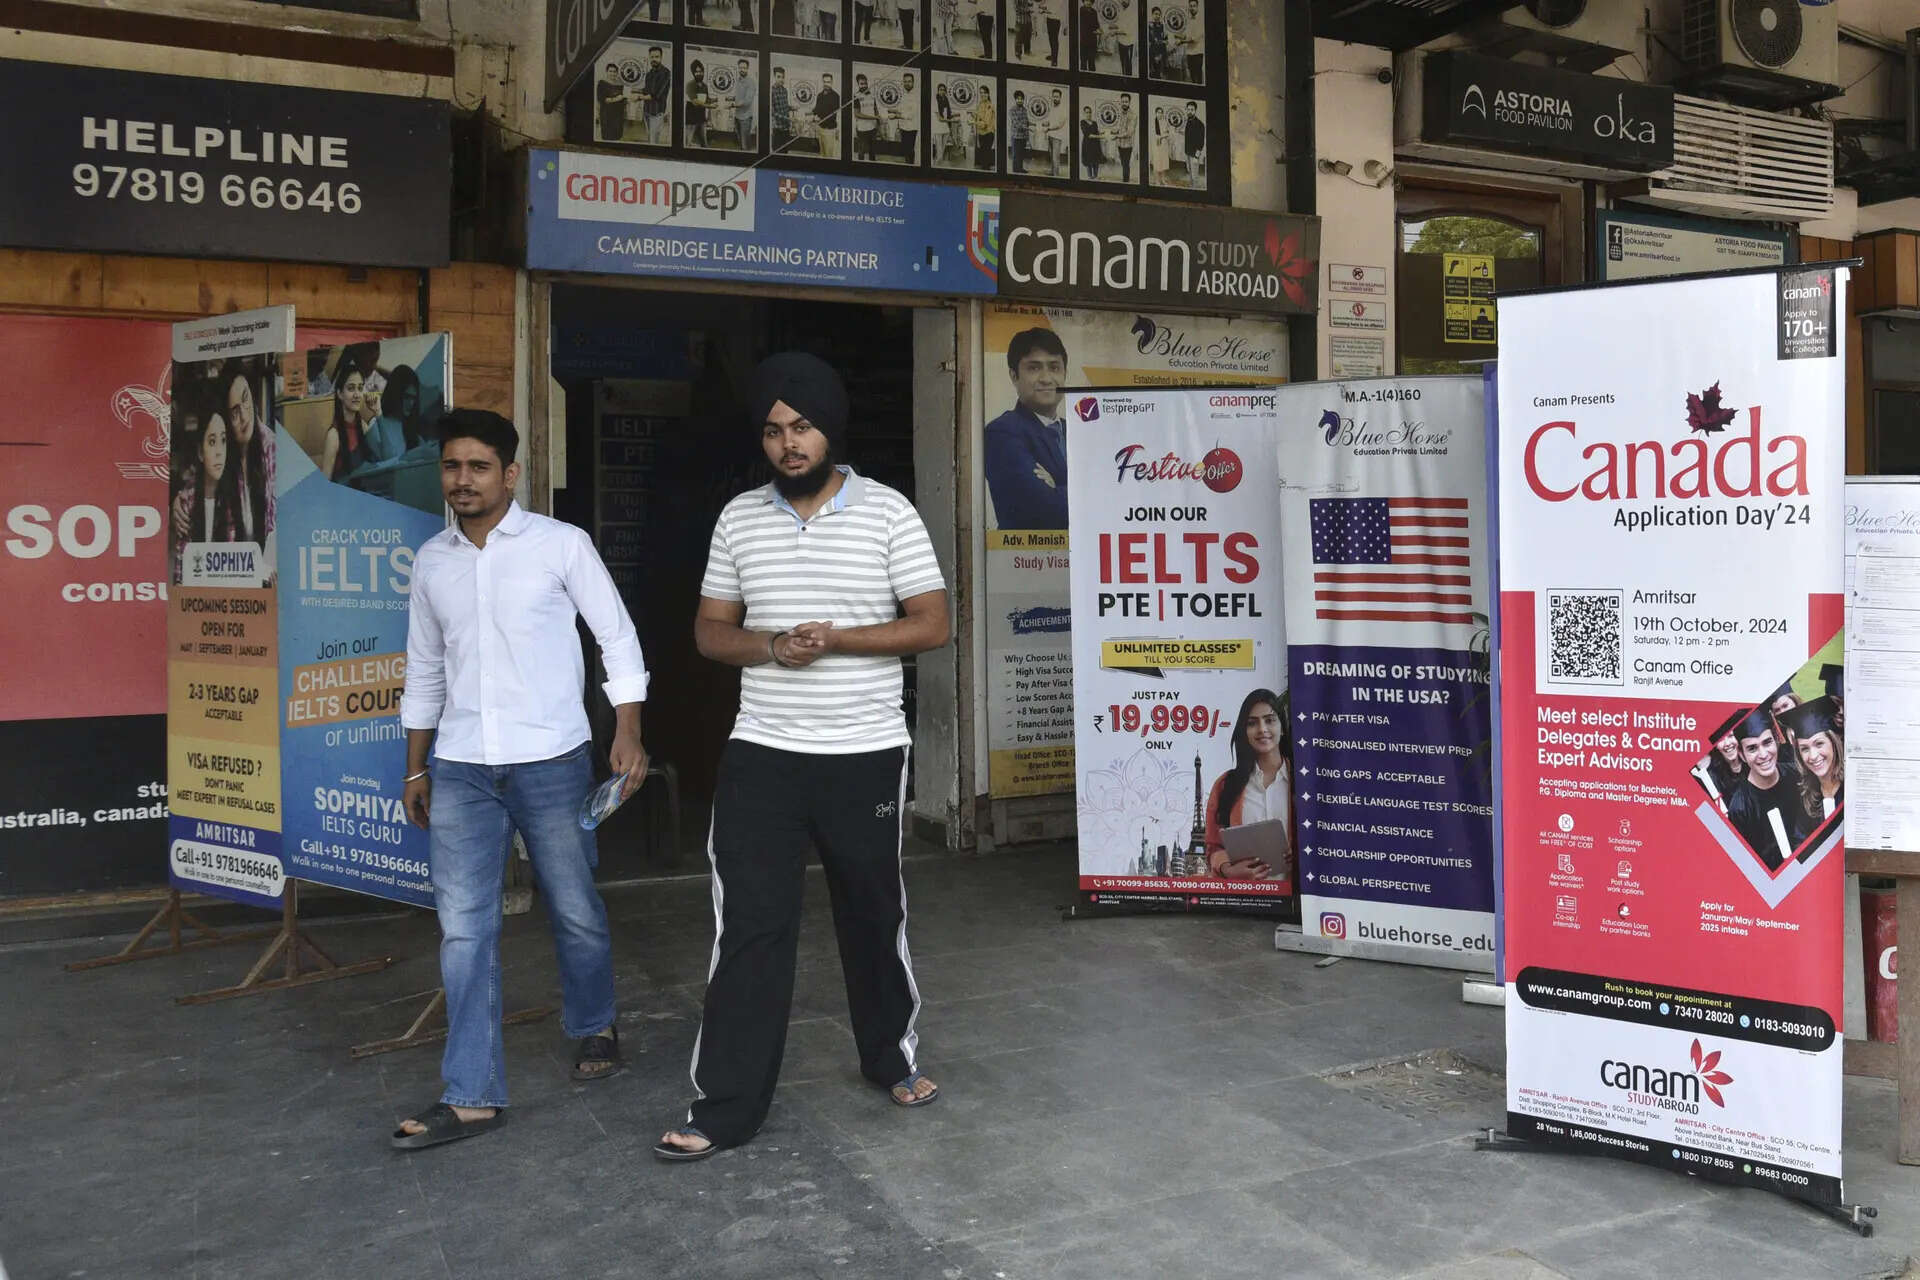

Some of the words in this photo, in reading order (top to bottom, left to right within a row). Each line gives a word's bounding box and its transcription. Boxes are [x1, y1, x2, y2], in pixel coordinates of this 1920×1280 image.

[1494, 90, 1573, 117] ASTORIA
[1495, 109, 1525, 124] FOOD
[1528, 114, 1573, 131] PAVILION
[1594, 92, 1656, 144] oka
[82, 116, 349, 168] HELPLINE
[73, 163, 205, 203] 97819
[220, 175, 362, 214] 66646
[566, 173, 739, 220] canamprep
[801, 183, 905, 208] CAMBRIDGE
[598, 236, 708, 260] CAMBRIDGE
[713, 243, 802, 265] LEARNING
[806, 249, 879, 270] PARTNER
[1005, 227, 1190, 292] canam
[1197, 240, 1259, 268] STUDY
[1196, 270, 1280, 298] ABROAD
[1784, 320, 1827, 337] 170+
[1149, 326, 1201, 358] Blue
[1207, 336, 1272, 364] Horse
[1169, 358, 1208, 369] Education
[1211, 360, 1238, 370] Private
[1241, 362, 1269, 372] Limited
[1533, 395, 1567, 407] Canam
[1571, 393, 1615, 406] Presents
[1338, 418, 1388, 446] Blue
[1386, 421, 1449, 446] Horse
[1354, 448, 1390, 456] Education
[1392, 448, 1418, 456] Private
[1420, 447, 1448, 455] Limited
[1524, 406, 1810, 502] Canada
[1115, 444, 1205, 484] Festive
[1124, 506, 1166, 521] JOIN
[1170, 507, 1207, 521] OUR
[1613, 505, 1727, 531] Application
[1736, 503, 1810, 529] Day'24
[5, 504, 162, 559] SOP
[311, 529, 358, 544] CRACK
[361, 529, 401, 544] YOUR
[1003, 534, 1024, 546] Adv.
[1028, 534, 1065, 546] Manish
[206, 551, 254, 572] SOPHIYA
[1014, 556, 1043, 570] Study
[1047, 556, 1069, 568] Visa
[1099, 532, 1259, 584] IELTS
[298, 546, 417, 594] IELTS
[1098, 592, 1150, 617] PTE
[1171, 592, 1262, 617] TOEFL
[1633, 590, 1696, 605] Amritsar
[1633, 617, 1664, 631] 19th
[1670, 617, 1743, 634] October,
[1749, 618, 1788, 634] 2024
[1114, 644, 1180, 653] UNLIMITED
[1633, 636, 1670, 646] Saturday,
[1673, 636, 1683, 645] 12
[1685, 639, 1699, 647] pm
[1707, 638, 1713, 646] 2
[1185, 656, 1215, 664] SCORE
[1633, 658, 1686, 675] Canam
[1690, 660, 1733, 675] Office
[1303, 662, 1386, 678] DREAMING
[1391, 665, 1411, 679] OF
[1415, 666, 1491, 685] STUDYING
[1633, 677, 1653, 686] Ranjit
[1655, 678, 1683, 686] Avenue
[188, 684, 203, 699] 2-3
[206, 685, 236, 702] YEARS
[239, 687, 259, 704] GAP
[1132, 692, 1157, 700] JUST
[1159, 692, 1180, 700] PAY
[1352, 687, 1370, 701] IN
[1375, 688, 1404, 703] THE
[1408, 689, 1450, 704] USA?
[204, 707, 242, 721] ACCEPTABLE
[1312, 712, 1330, 722] PAY
[1332, 714, 1364, 724] AFTER
[1367, 715, 1390, 725] VISA
[1537, 707, 1577, 724] Meet
[1581, 709, 1628, 727] select
[1633, 711, 1696, 731] Institute
[1146, 741, 1172, 750] ONLY
[1312, 738, 1386, 751] PERSONALISED
[1388, 743, 1446, 755] INTERVIEW
[1448, 746, 1473, 757] PREP
[1537, 728, 1616, 749] Delegates
[1621, 734, 1632, 748] &
[1638, 735, 1700, 752] Canam
[187, 752, 208, 770] VISA
[211, 755, 254, 775] REFUSED
[1537, 750, 1585, 769] Expert
[1589, 753, 1653, 772] Advisors
[340, 774, 356, 784] Join
[357, 776, 380, 791] today
[1316, 767, 1340, 779] LONG
[1343, 769, 1372, 780] GAPS
[1377, 772, 1445, 785] ACCEPTABLE
[1539, 777, 1577, 790] Accepting
[1579, 781, 1627, 793] applications
[1629, 784, 1639, 792] for
[1641, 785, 1677, 796] Bachelor,
[314, 787, 408, 825] SOPHIYA
[1316, 793, 1361, 806] FLEXIBLE
[1364, 797, 1420, 810] LANGUAGE
[1423, 801, 1449, 811] TEST
[1452, 803, 1494, 816] SCORES
[195, 822, 255, 848] AMRITSAR
[322, 815, 355, 835] IELTS
[359, 821, 401, 845] GURU
[1317, 821, 1367, 833] FINANCIAL
[1370, 825, 1433, 839] ASSISTANCE
[175, 847, 213, 868] Call+91
[216, 854, 279, 881] 9781966646
[301, 839, 347, 860] Call+91
[350, 849, 429, 877] 9781966646
[1317, 847, 1386, 861] SCHOLARSHIP
[1389, 854, 1473, 869] OPPORTUNITIES
[1319, 875, 1359, 886] GLOBAL
[1362, 878, 1431, 893] PERSPECTIVE
[1528, 983, 1651, 1010] www.canamgroup.com
[1605, 983, 1623, 991] Rush
[1625, 985, 1633, 993] to
[1635, 987, 1653, 997] book
[1656, 991, 1672, 1000] your
[1674, 993, 1721, 1008] appointment
[1724, 1000, 1732, 1008] at
[1674, 1005, 1703, 1020] 73470
[1706, 1009, 1734, 1024] 28020
[1754, 1018, 1825, 1038] 0183-5093010
[1600, 1059, 1699, 1102] canam
[1628, 1092, 1699, 1115] STUDYABROAD
[1546, 1123, 1564, 1134] Years
[1570, 1129, 1597, 1142] 1,85,000
[1598, 1133, 1624, 1146] Success
[1625, 1137, 1649, 1151] Stories
[1681, 1151, 1699, 1162] 1800
[1700, 1154, 1713, 1164] 137
[1714, 1157, 1734, 1170] 8055
[1755, 1166, 1781, 1180] 89683
[1782, 1172, 1809, 1187] 00000
